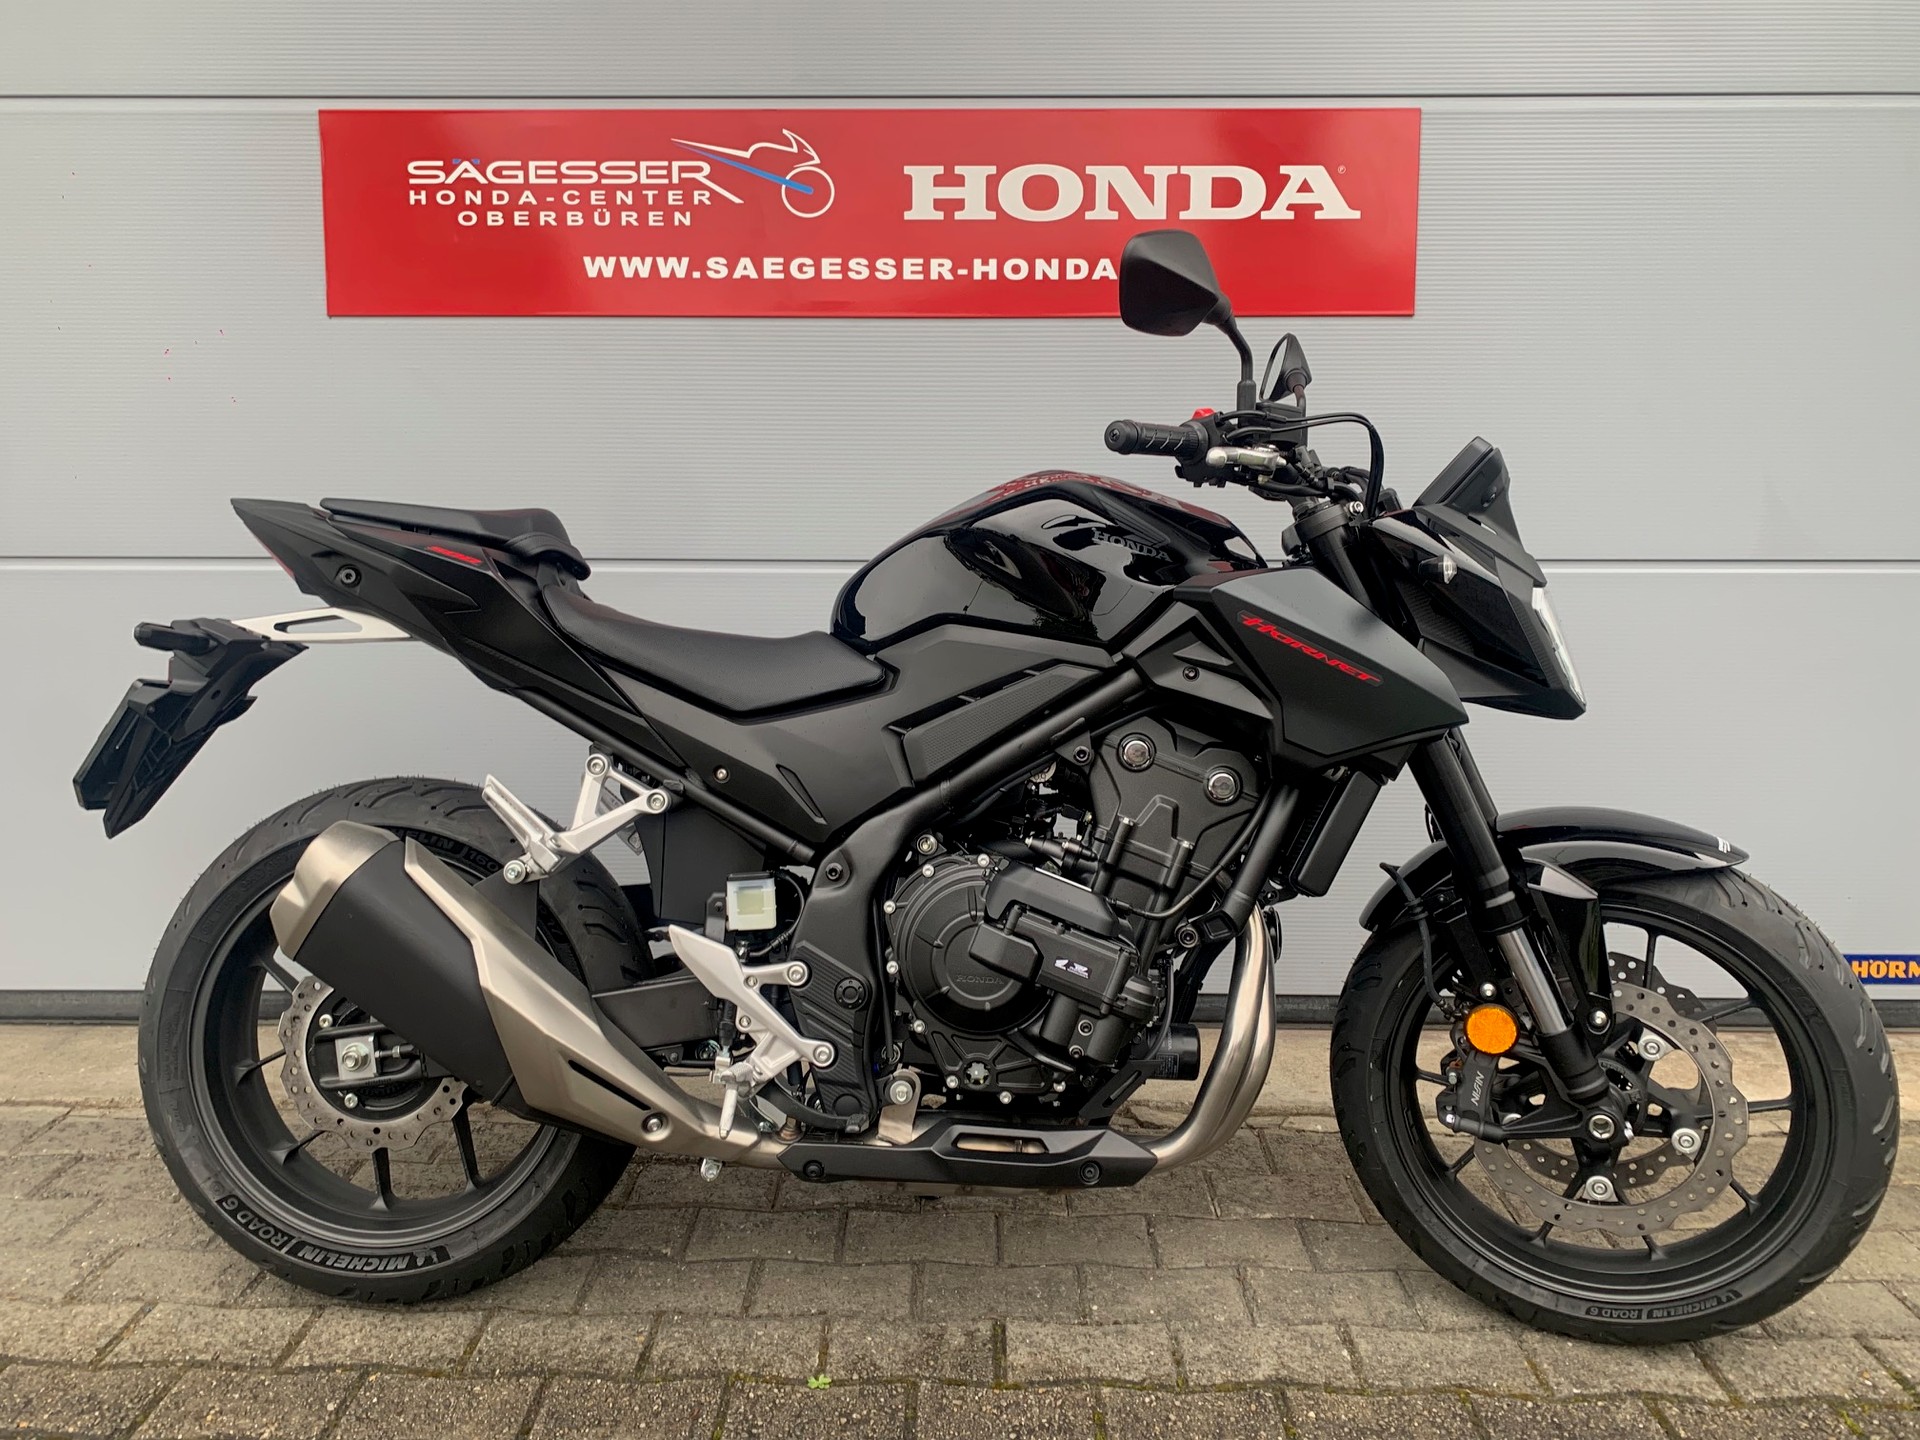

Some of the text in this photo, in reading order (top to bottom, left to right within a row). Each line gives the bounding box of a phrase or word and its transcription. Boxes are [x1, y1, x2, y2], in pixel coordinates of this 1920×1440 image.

[407, 158, 744, 197] SÄGESSER
[903, 164, 1361, 222] HONDA
[408, 189, 712, 206] HONDA-CENTER
[457, 208, 691, 227] OBERBÜREN
[1091, 527, 1173, 562] HONDA
[1241, 615, 1381, 682] HORNET
[955, 974, 1004, 985] HONDA
[222, 1196, 410, 1272] MICHELIN ROAD 6
[1589, 1296, 1718, 1319] MICHELIN ROAD 6
